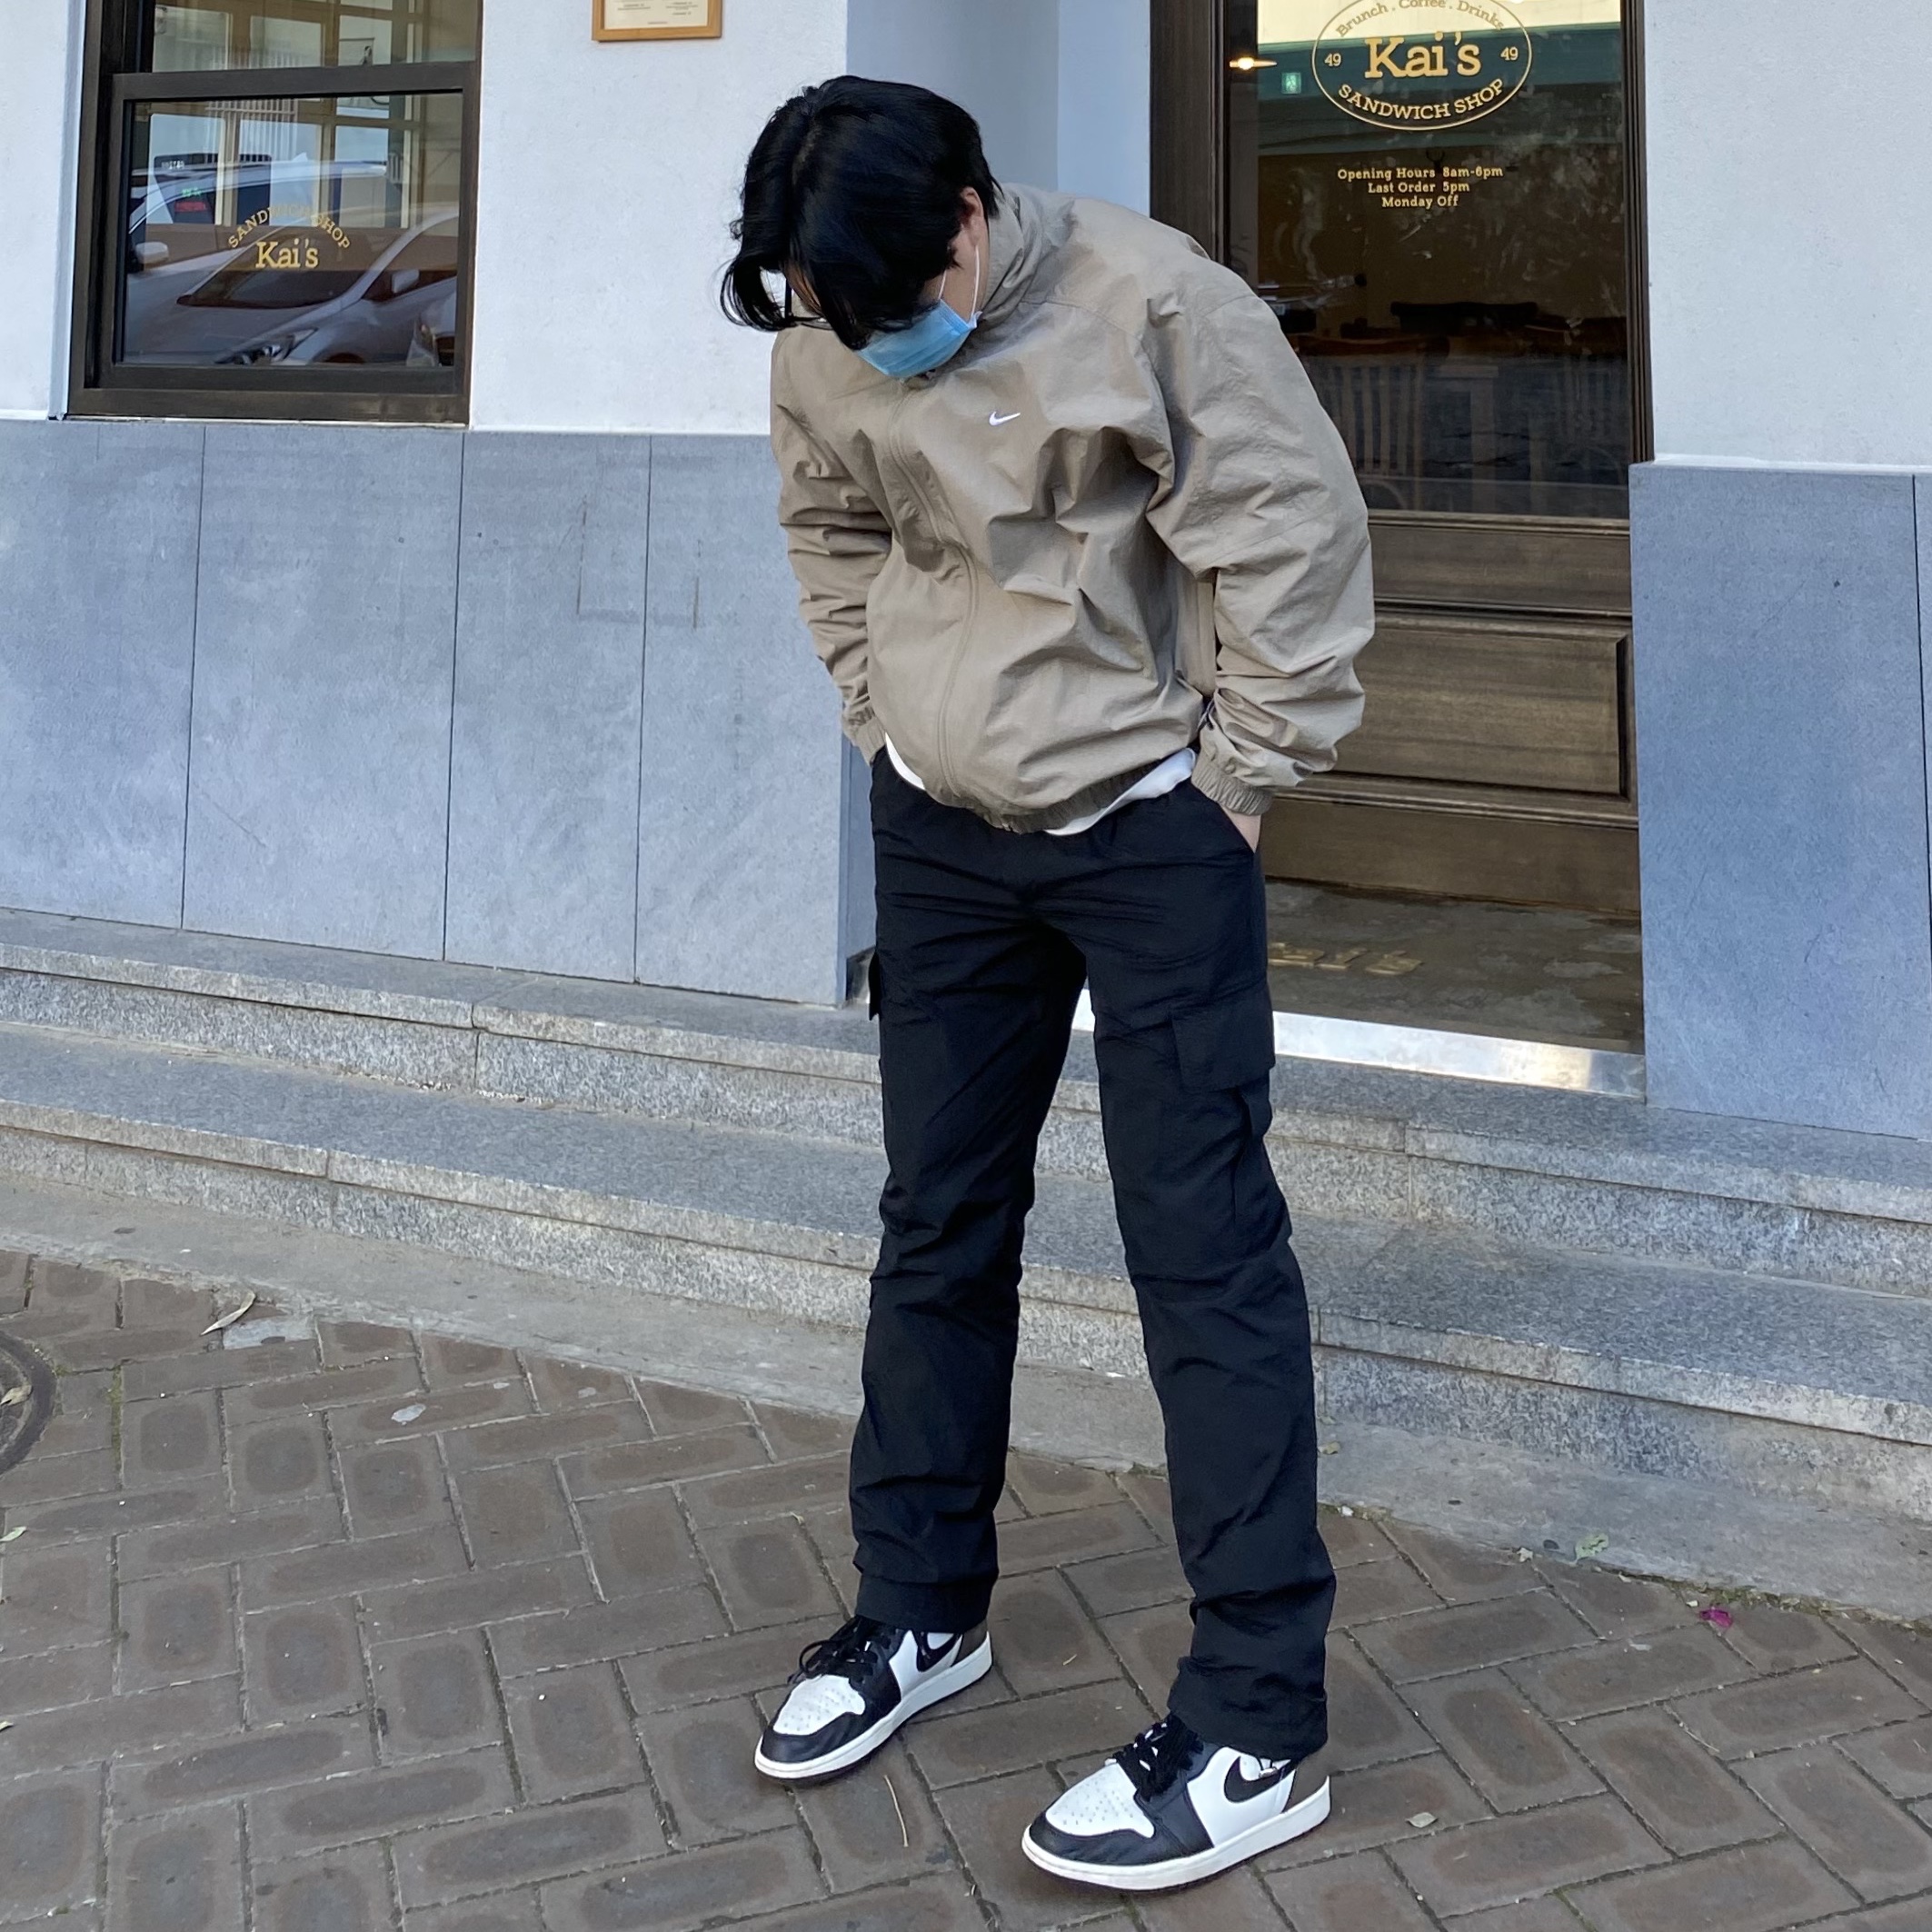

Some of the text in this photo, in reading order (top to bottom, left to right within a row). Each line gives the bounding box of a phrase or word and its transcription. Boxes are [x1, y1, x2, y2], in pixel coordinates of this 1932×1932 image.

[1336, 2, 1389, 37] Brunch
[1457, 3, 1505, 31] Drinks
[1324, 53, 1341, 67] 49
[1364, 31, 1482, 79] Kai's
[1500, 46, 1519, 61] 49
[1339, 78, 1504, 120] SANDWICH SHOP
[1338, 165, 1504, 182] Opening Hours 8am-6pm
[1368, 181, 1470, 194] Last Order 5pm
[1381, 194, 1459, 209] Monday Off
[255, 238, 319, 269] Kai's
